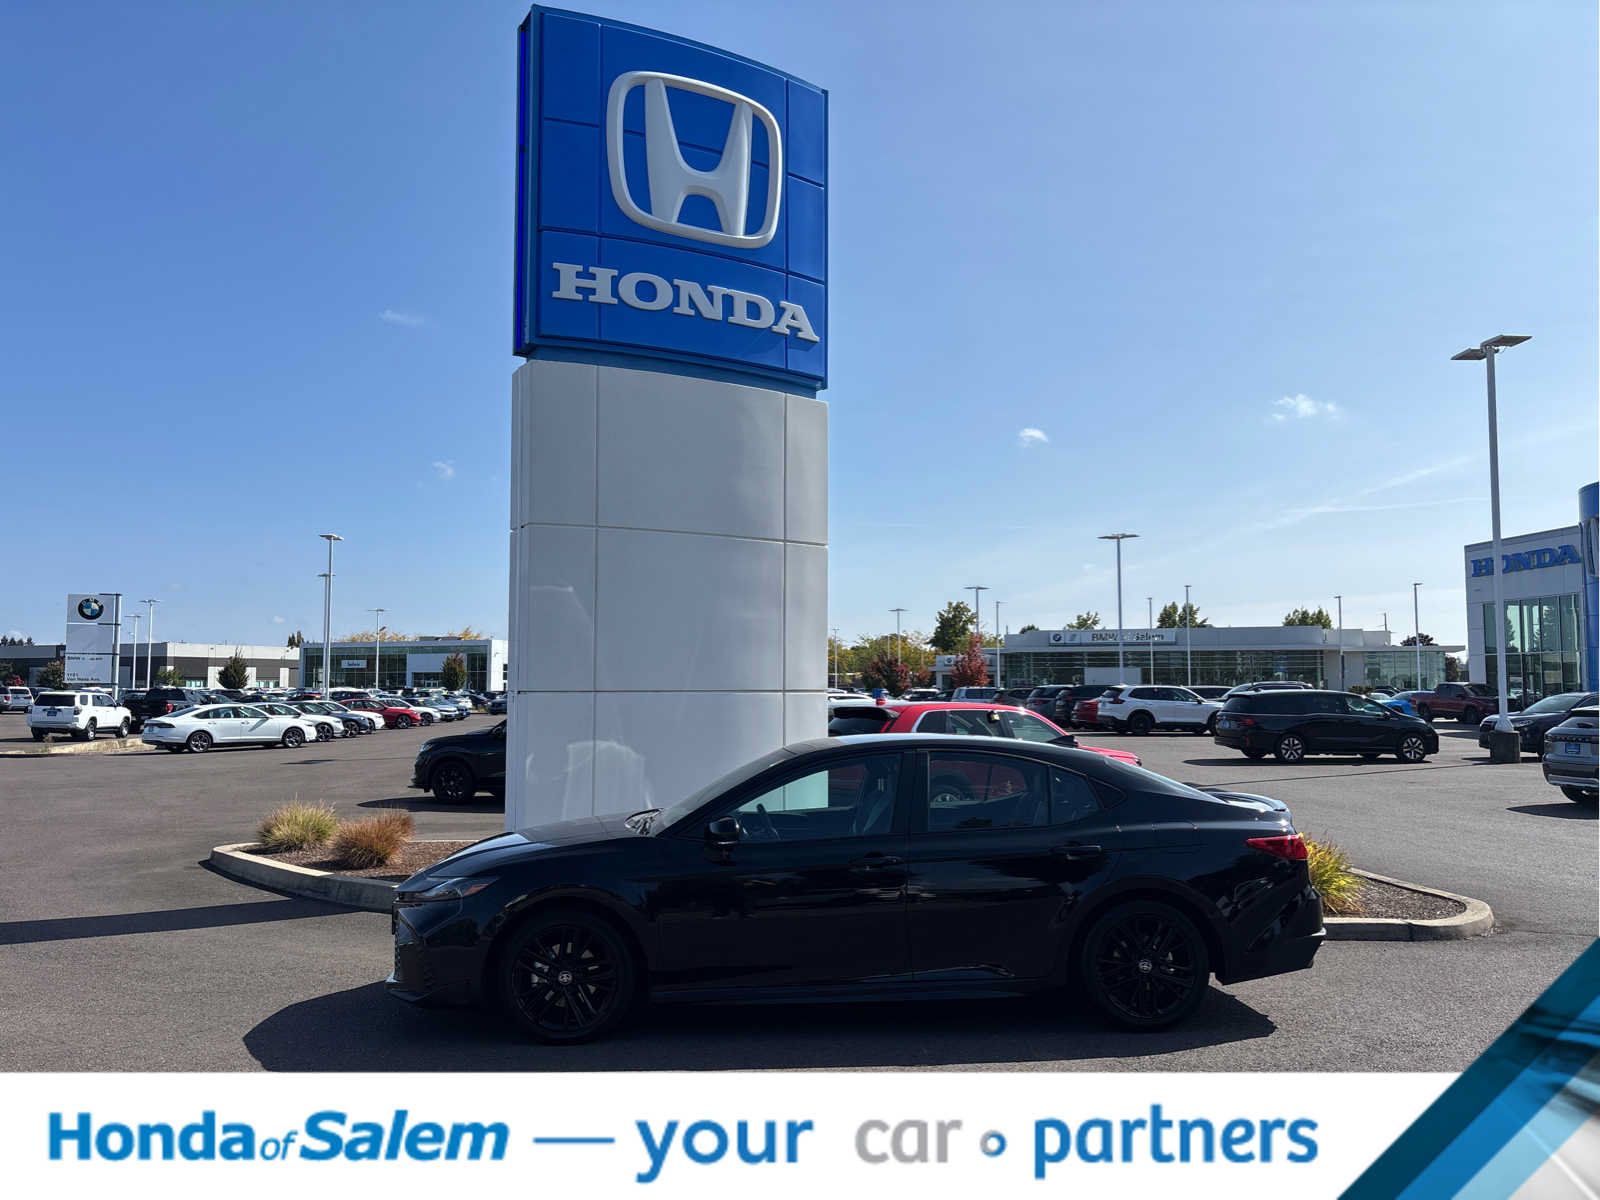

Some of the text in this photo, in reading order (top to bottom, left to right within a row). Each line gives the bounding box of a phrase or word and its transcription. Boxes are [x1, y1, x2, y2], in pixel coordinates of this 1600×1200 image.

[552, 262, 820, 343] HONDA
[1471, 545, 1581, 577] HONDA
[1092, 633, 1118, 641] BMW
